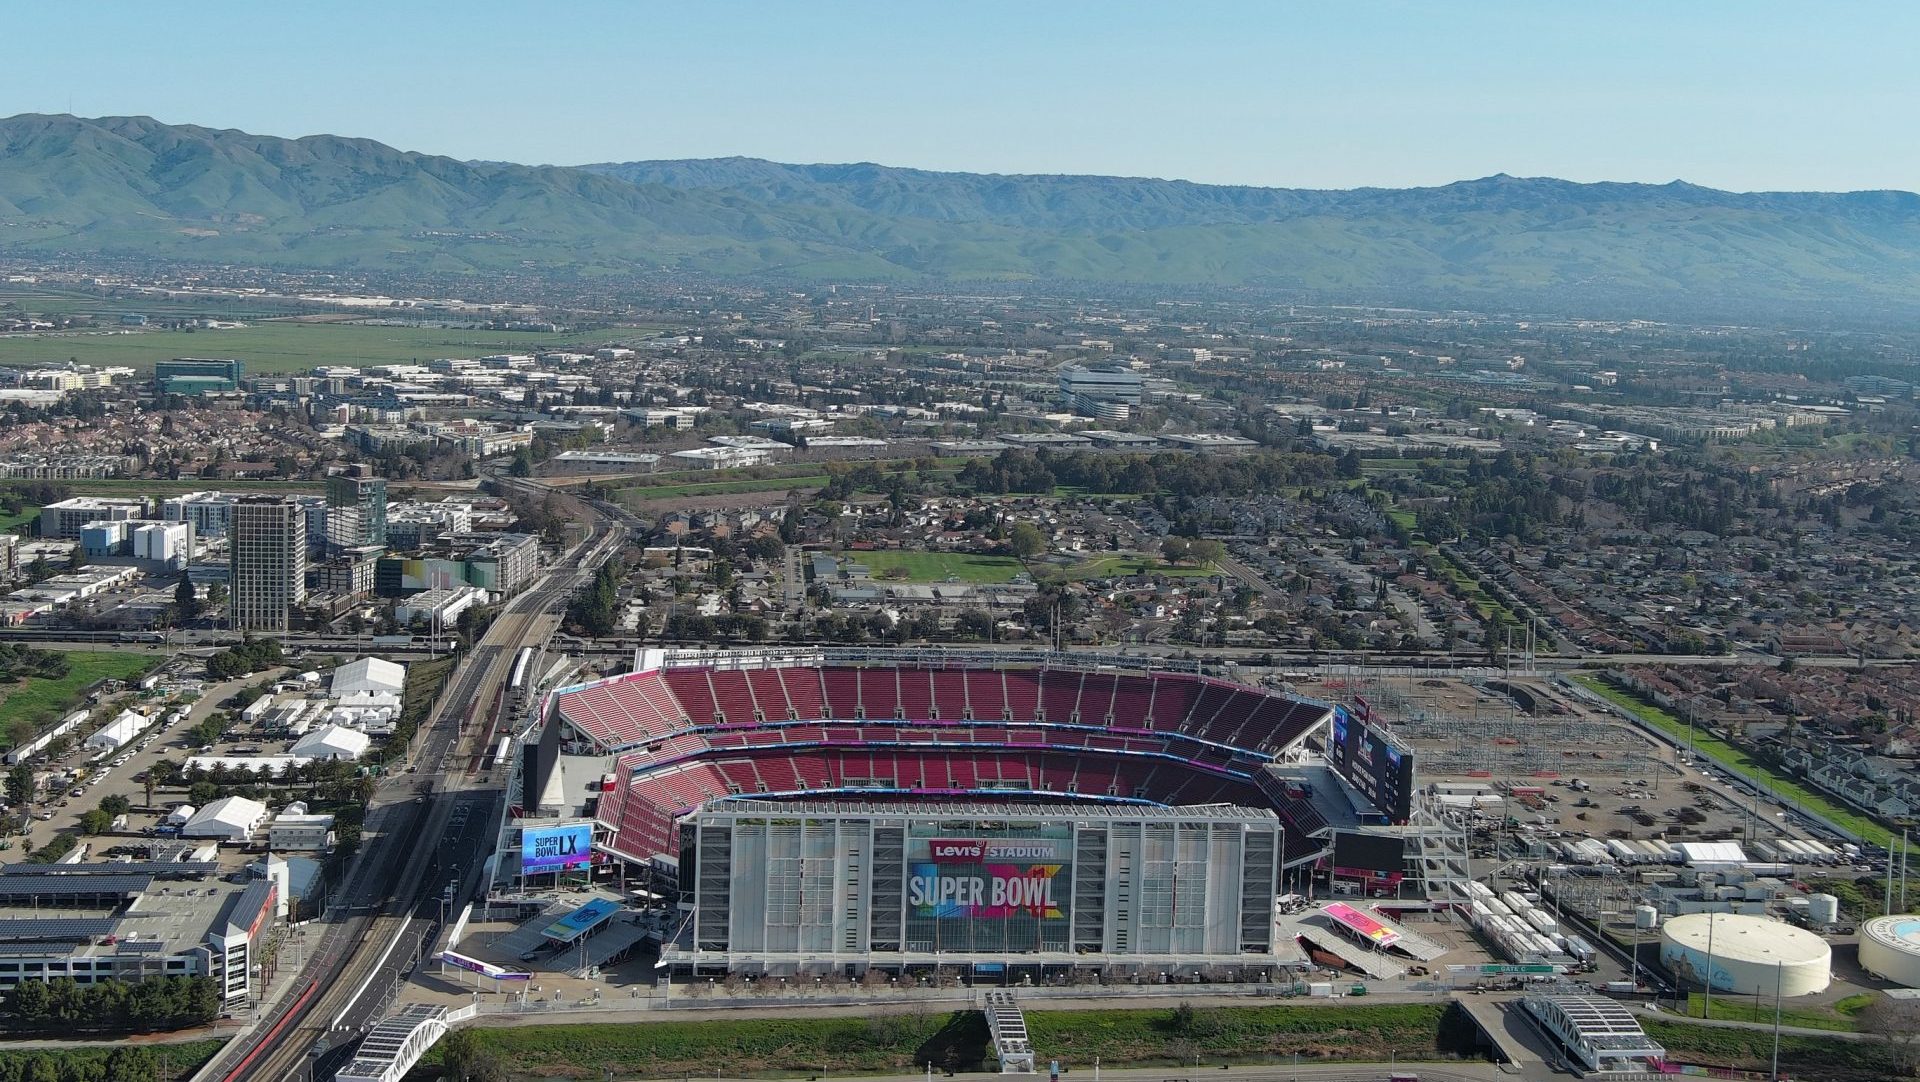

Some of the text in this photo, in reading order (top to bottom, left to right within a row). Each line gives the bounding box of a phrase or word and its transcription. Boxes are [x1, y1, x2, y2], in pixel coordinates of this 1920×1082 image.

[535, 837, 558, 848] SUPER
[559, 834, 577, 855] LX
[535, 846, 558, 858] BOWL
[989, 847, 1054, 858] STADIUM
[909, 876, 1057, 906] SUPER BOWL
